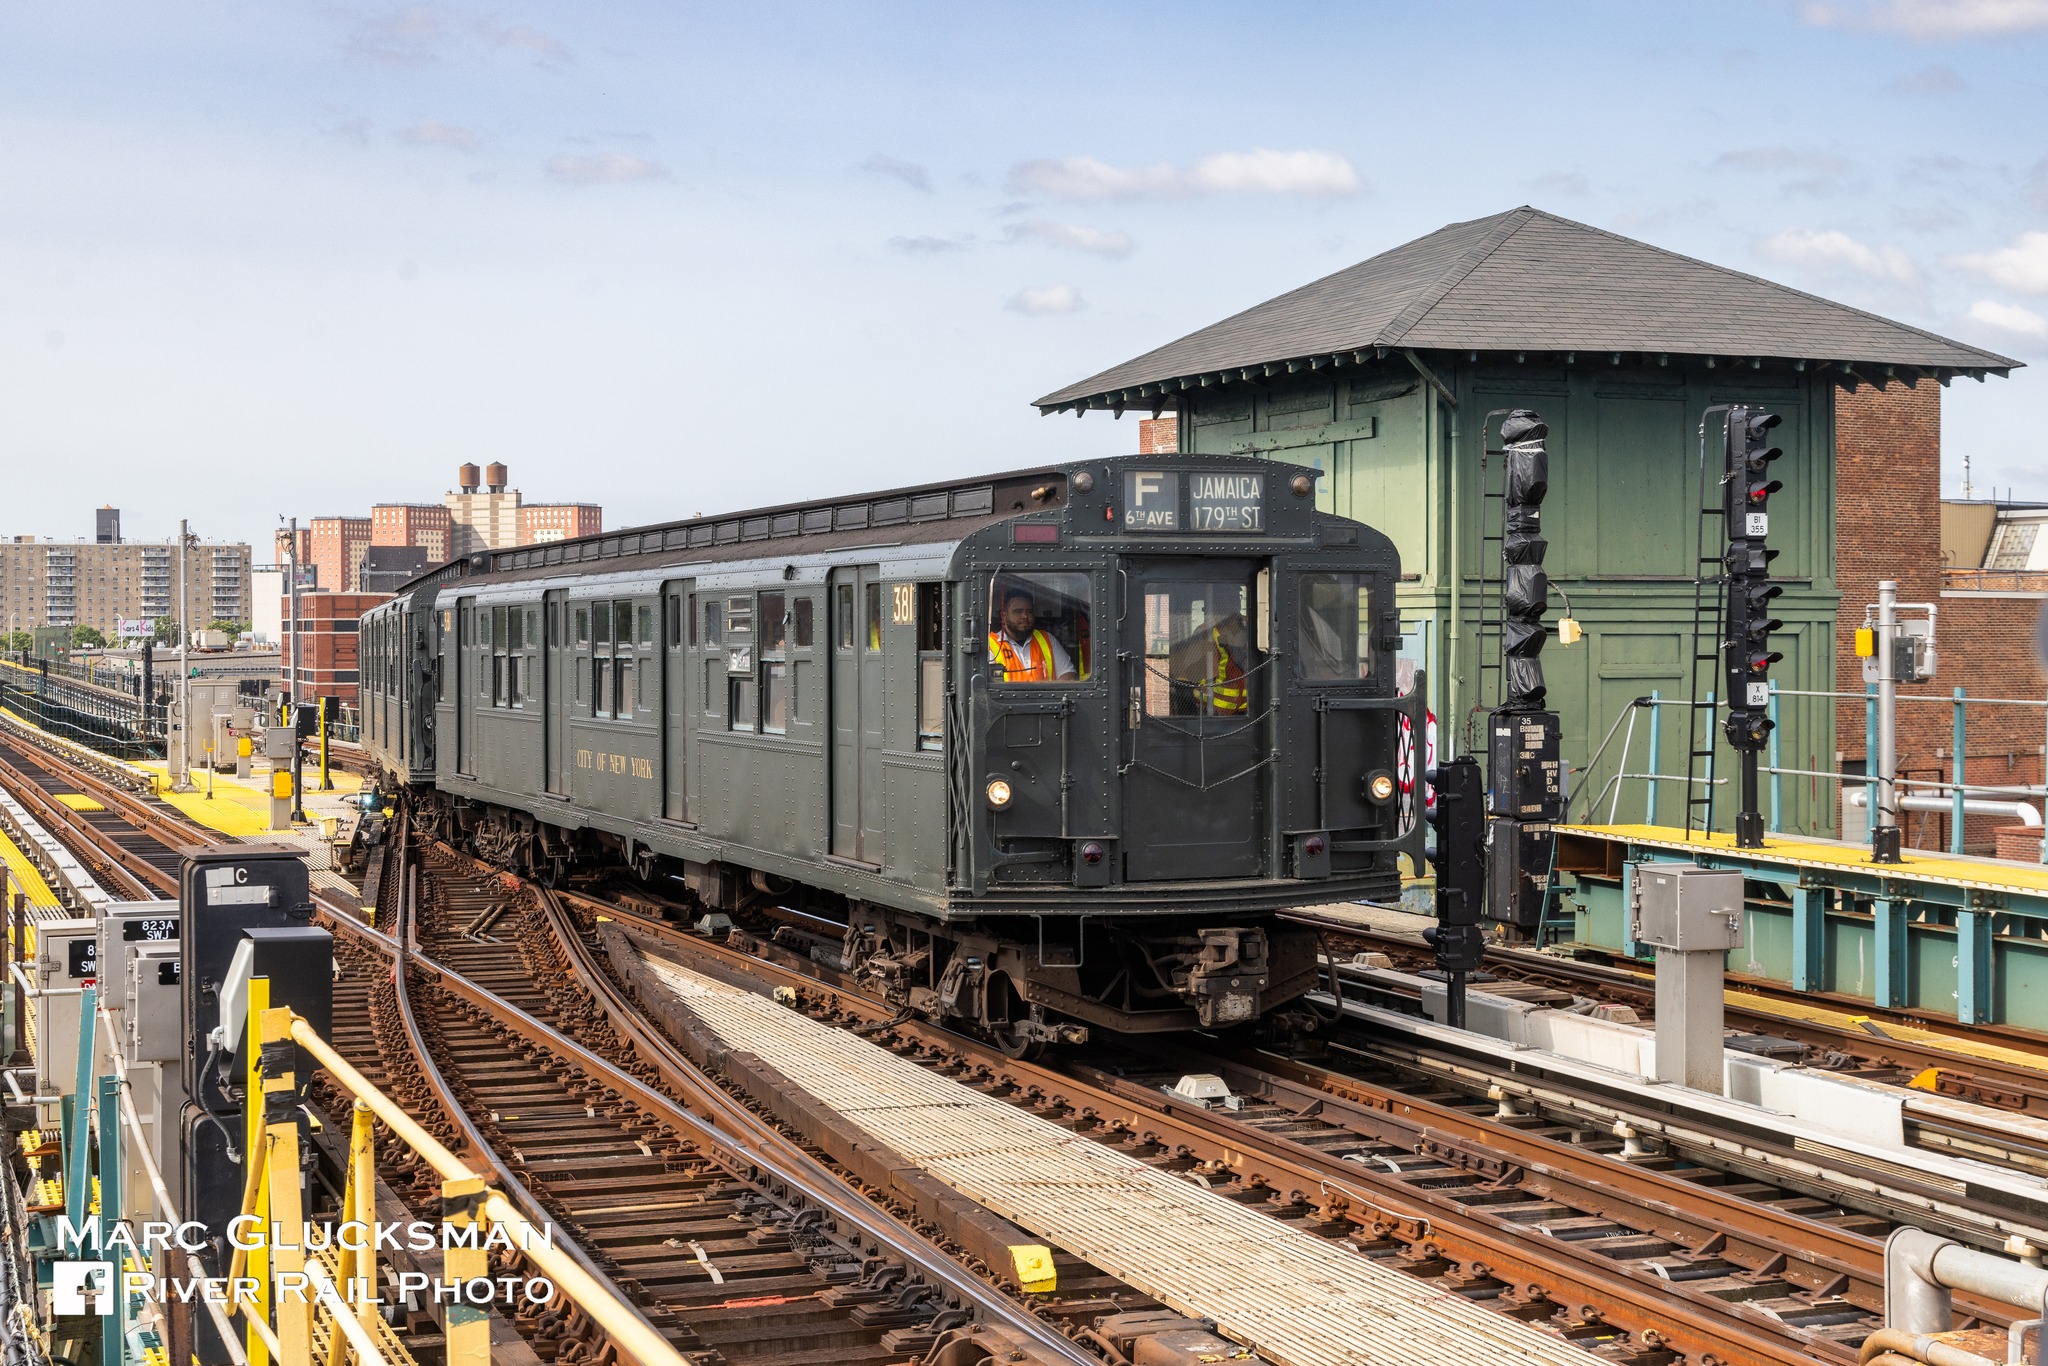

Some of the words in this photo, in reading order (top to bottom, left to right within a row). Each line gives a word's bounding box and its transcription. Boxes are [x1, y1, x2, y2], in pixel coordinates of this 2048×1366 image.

[1135, 472, 1163, 506] F
[1193, 477, 1260, 499] JAMAICA
[1125, 510, 1146, 525] 6TH
[1195, 506, 1238, 528] 179TH
[1751, 525, 1764, 533] 355
[893, 584, 913, 622] 381
[1755, 685, 1760, 693] X
[1521, 717, 1532, 725] 35
[576, 749, 593, 769] CITY
[596, 752, 607, 771] OF
[609, 753, 627, 774] NEW
[631, 756, 653, 779] YORK
[1546, 769, 1557, 777] HV
[235, 867, 248, 884] C
[142, 920, 174, 931] 823A
[146, 930, 169, 940] SWJ
